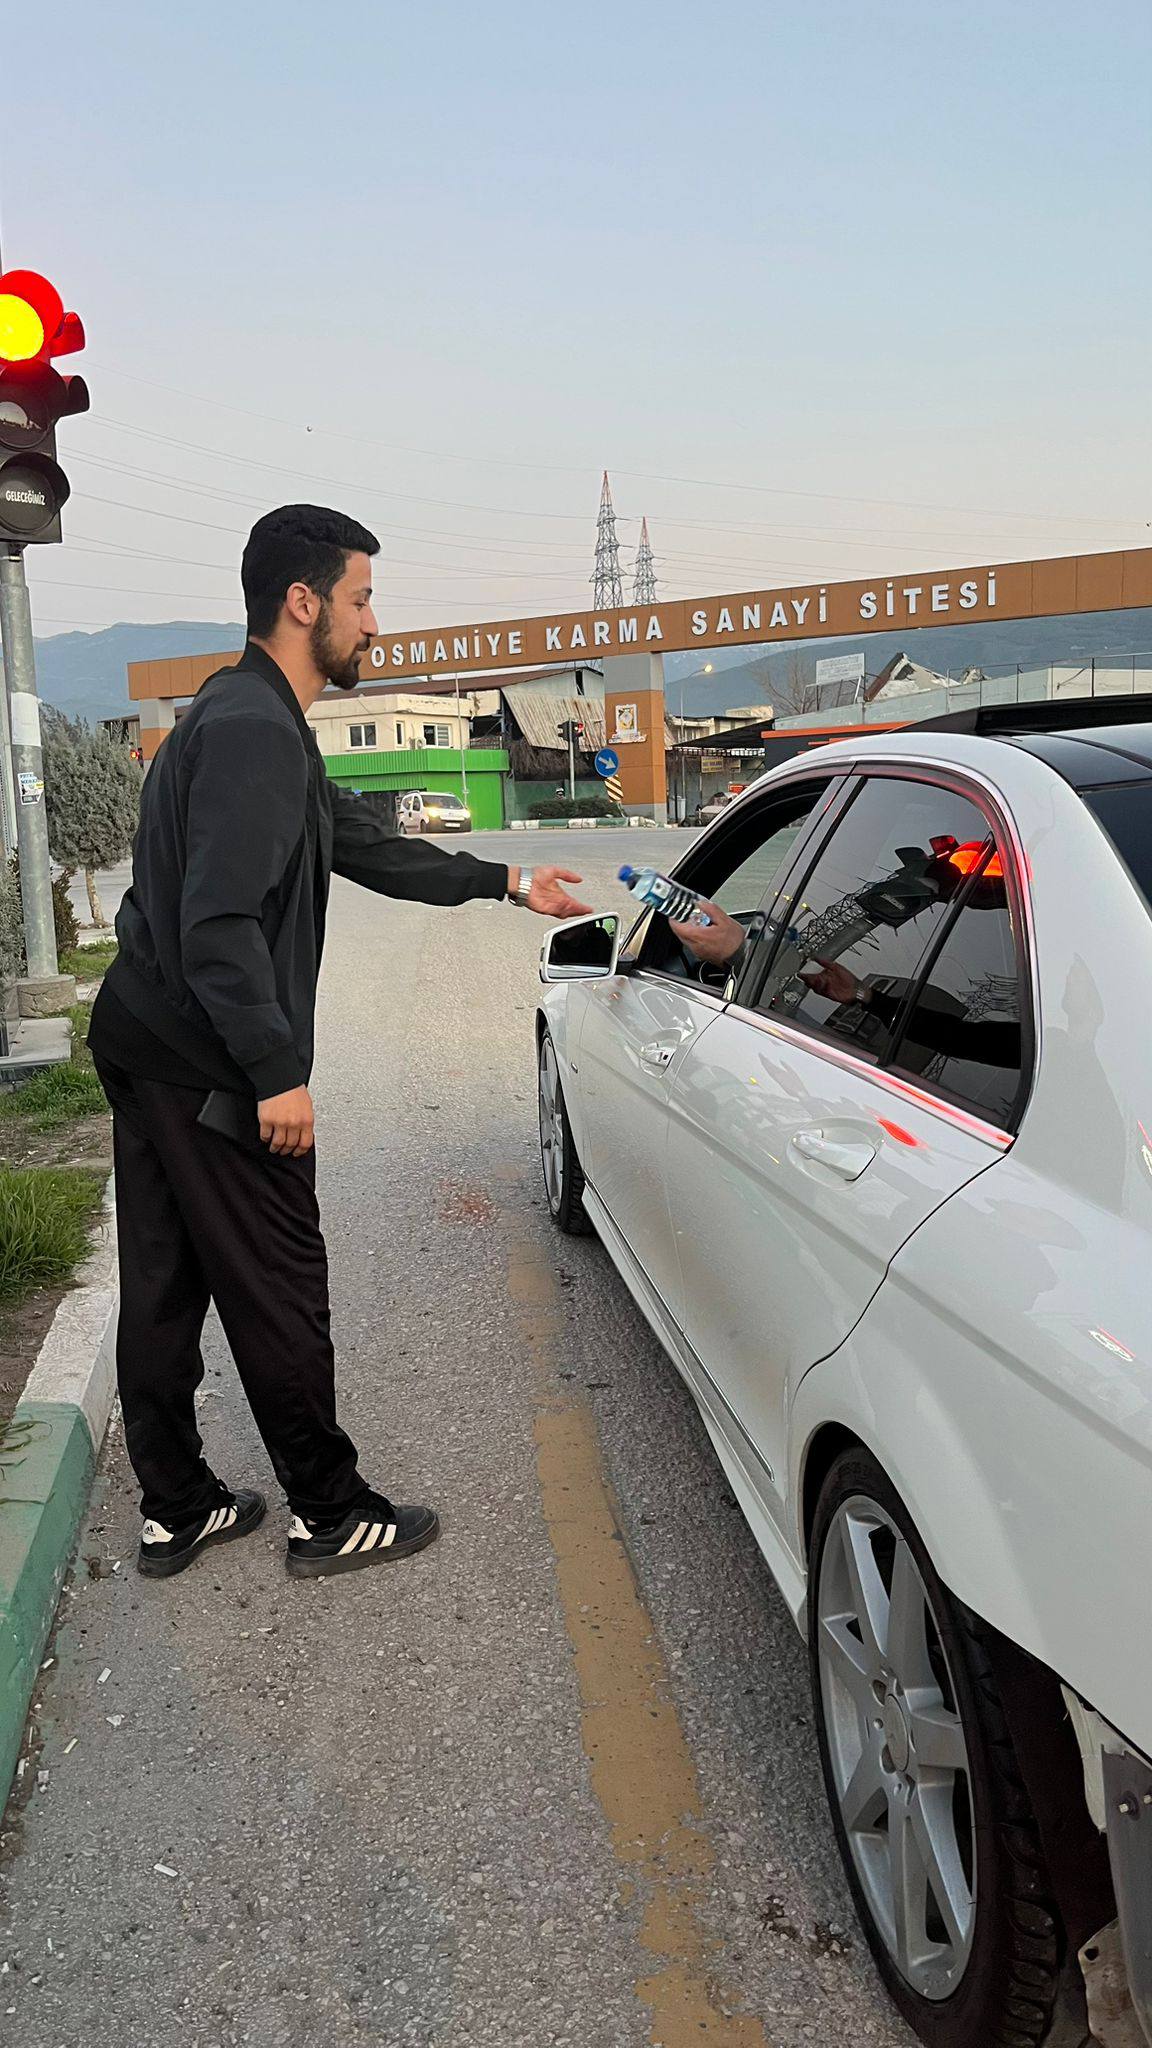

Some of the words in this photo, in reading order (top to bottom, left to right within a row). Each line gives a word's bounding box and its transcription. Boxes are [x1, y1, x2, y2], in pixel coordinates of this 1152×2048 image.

[5, 490, 45, 505] GELECEĞİMİZ
[370, 629, 522, 668] OSMANİYE
[546, 615, 663, 651] KARMA
[691, 588, 827, 636] SANAYİ
[859, 571, 997, 619] SİTESİ
